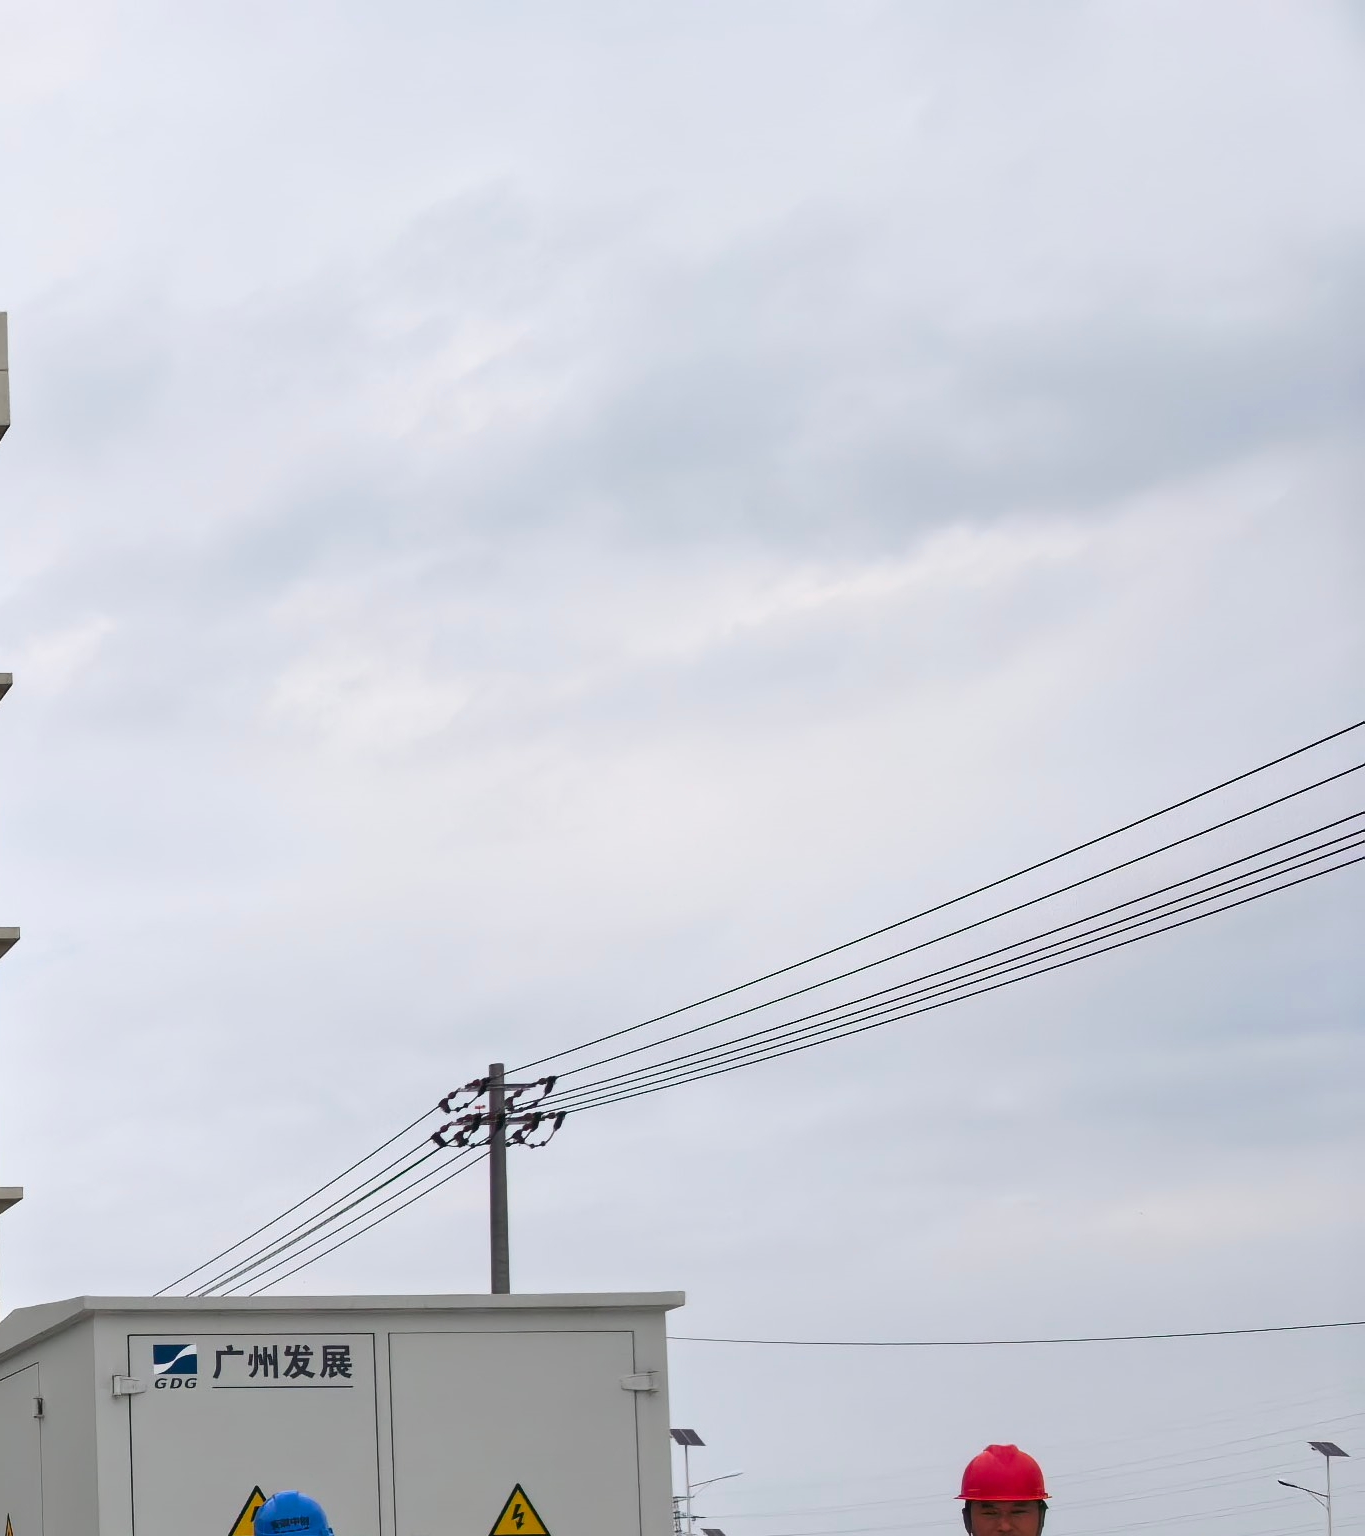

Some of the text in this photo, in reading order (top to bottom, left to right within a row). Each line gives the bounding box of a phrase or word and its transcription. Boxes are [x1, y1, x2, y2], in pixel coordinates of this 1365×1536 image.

[213, 1344, 353, 1379] 广州发展
[154, 1377, 197, 1389] GDG
